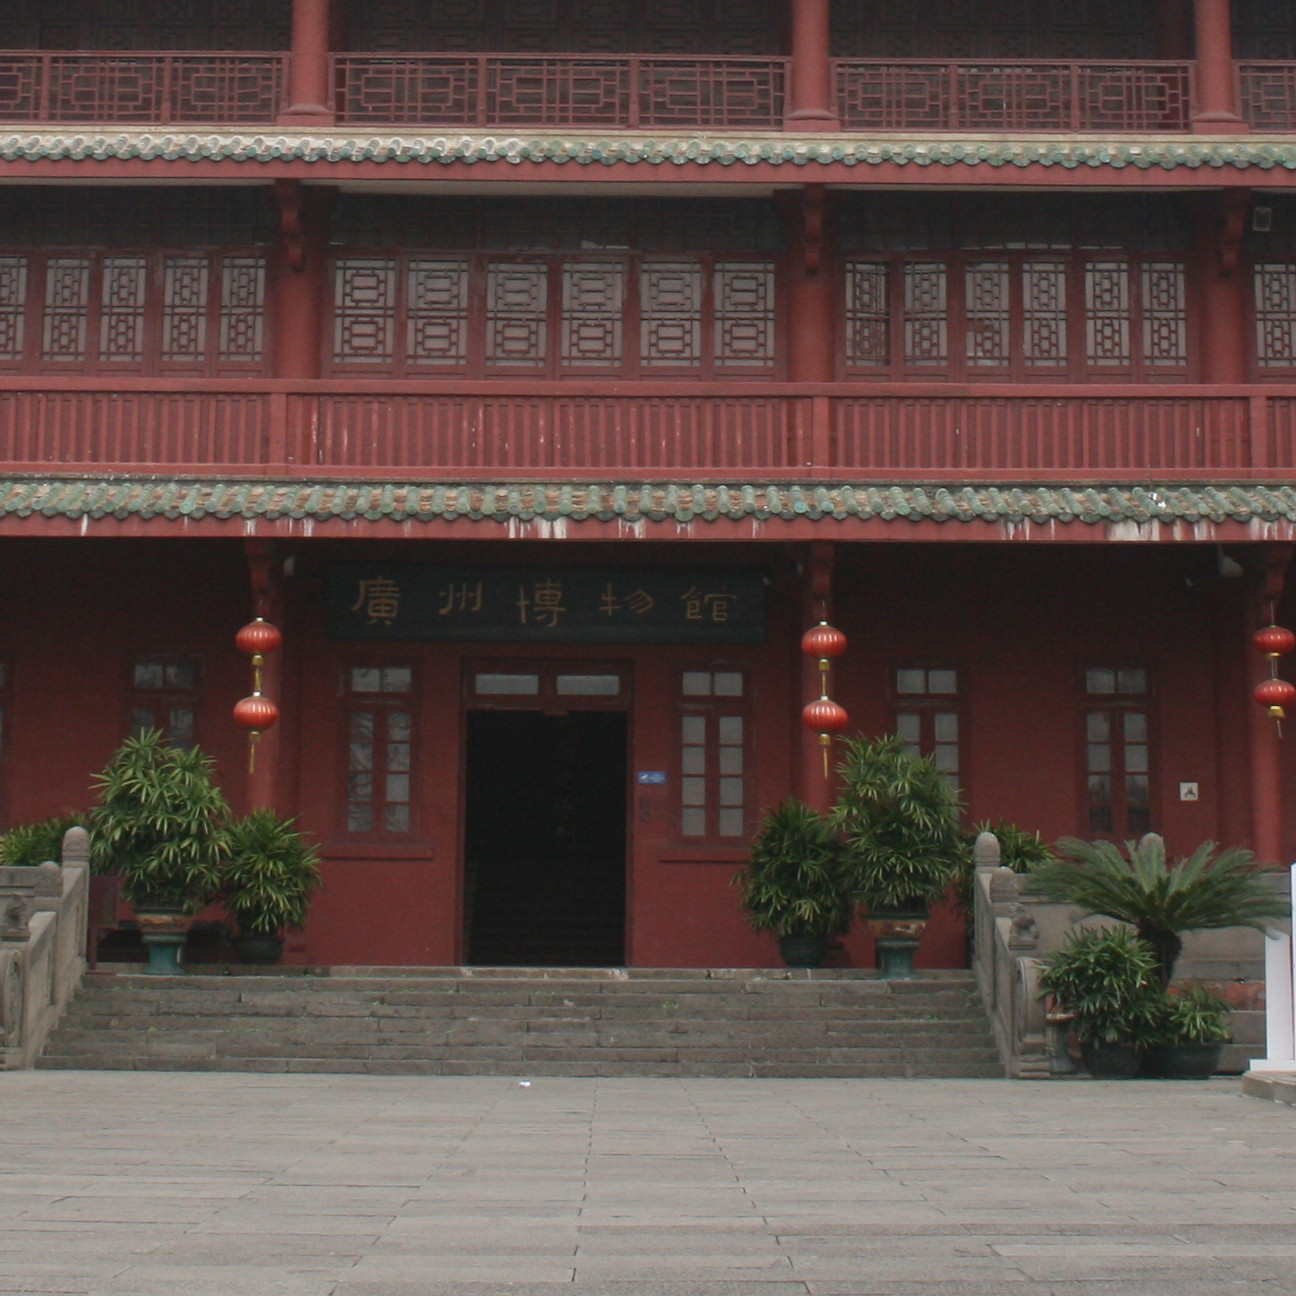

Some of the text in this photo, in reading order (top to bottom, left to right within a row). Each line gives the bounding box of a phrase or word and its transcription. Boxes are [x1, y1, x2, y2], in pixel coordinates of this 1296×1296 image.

[352, 576, 737, 627] 廣州博物館
